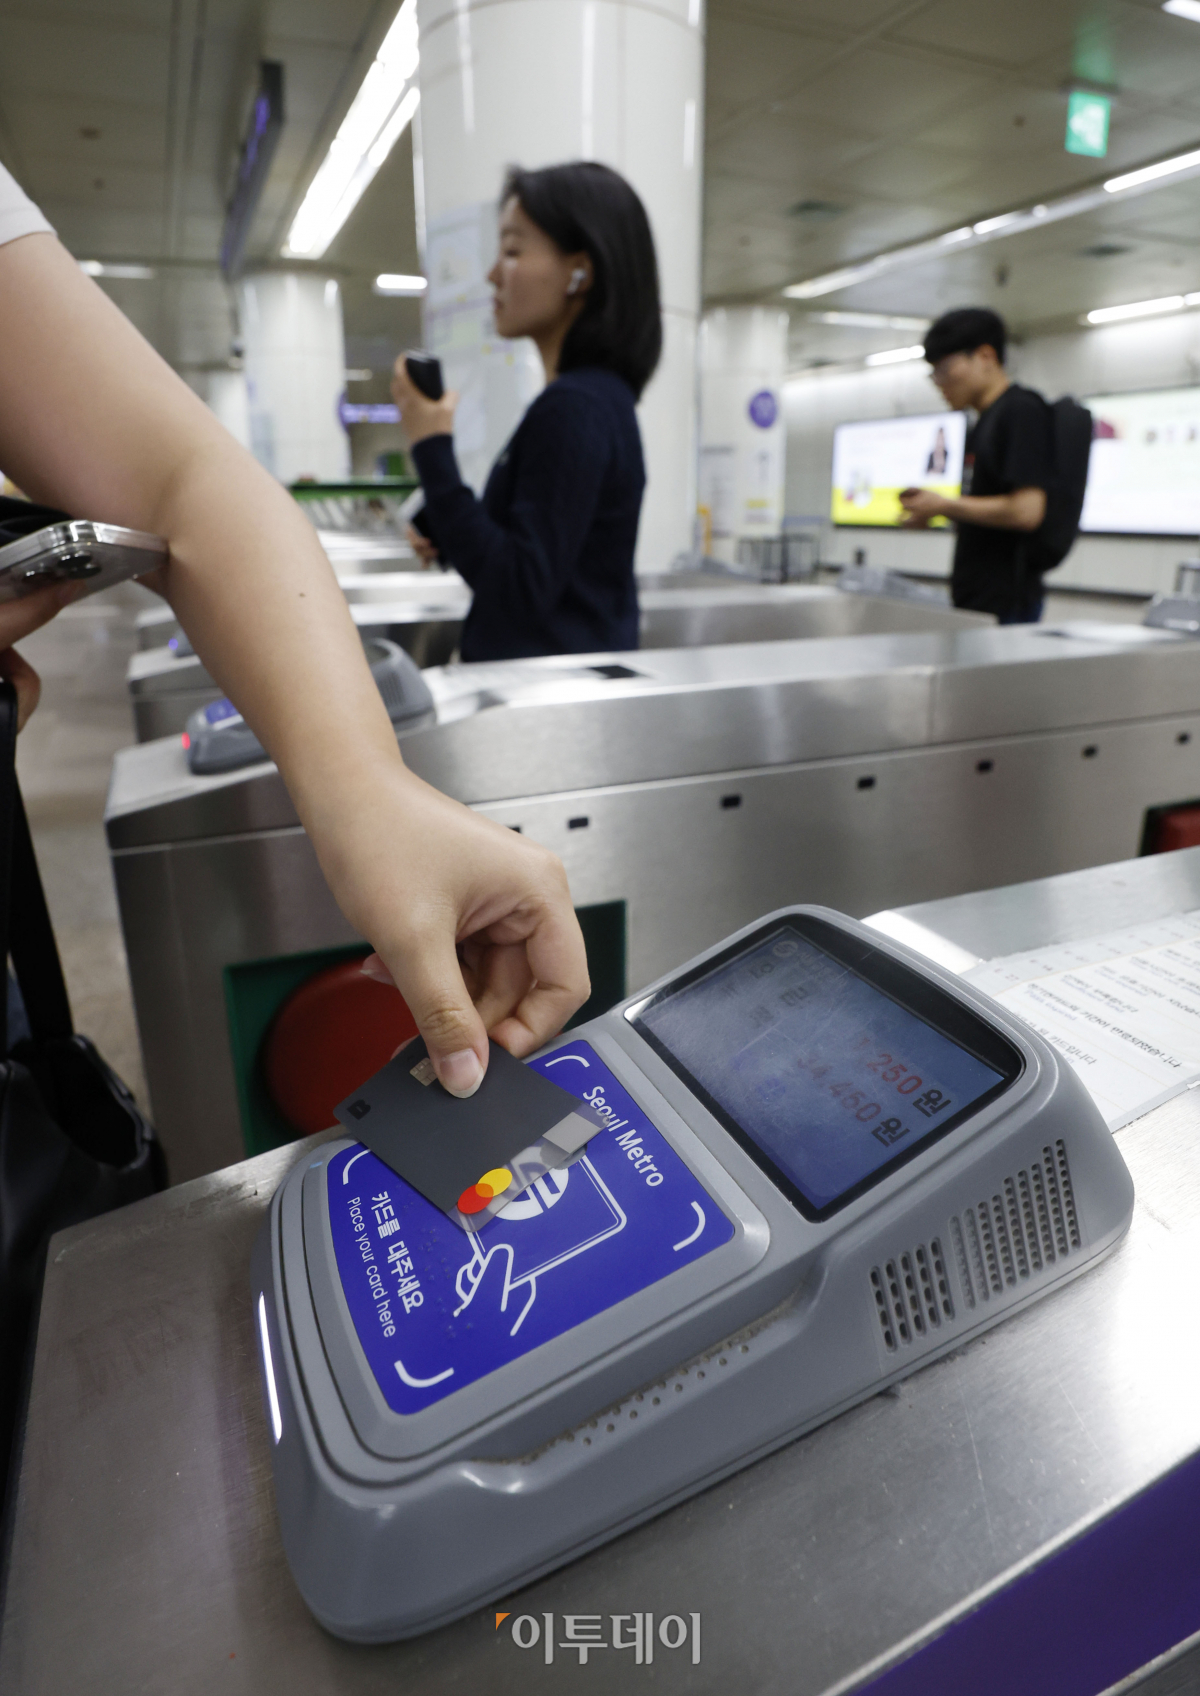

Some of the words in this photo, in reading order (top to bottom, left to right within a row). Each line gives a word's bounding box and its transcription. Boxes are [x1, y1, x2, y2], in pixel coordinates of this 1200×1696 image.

[582, 1085, 629, 1132] Seoul
[614, 1128, 664, 1187] Metro
[347, 1196, 366, 1233] Place
[355, 1232, 375, 1263] your
[371, 1191, 401, 1239] 카드를
[387, 1240, 425, 1314] 대주세요
[366, 1265, 388, 1300] card
[376, 1299, 397, 1338] here
